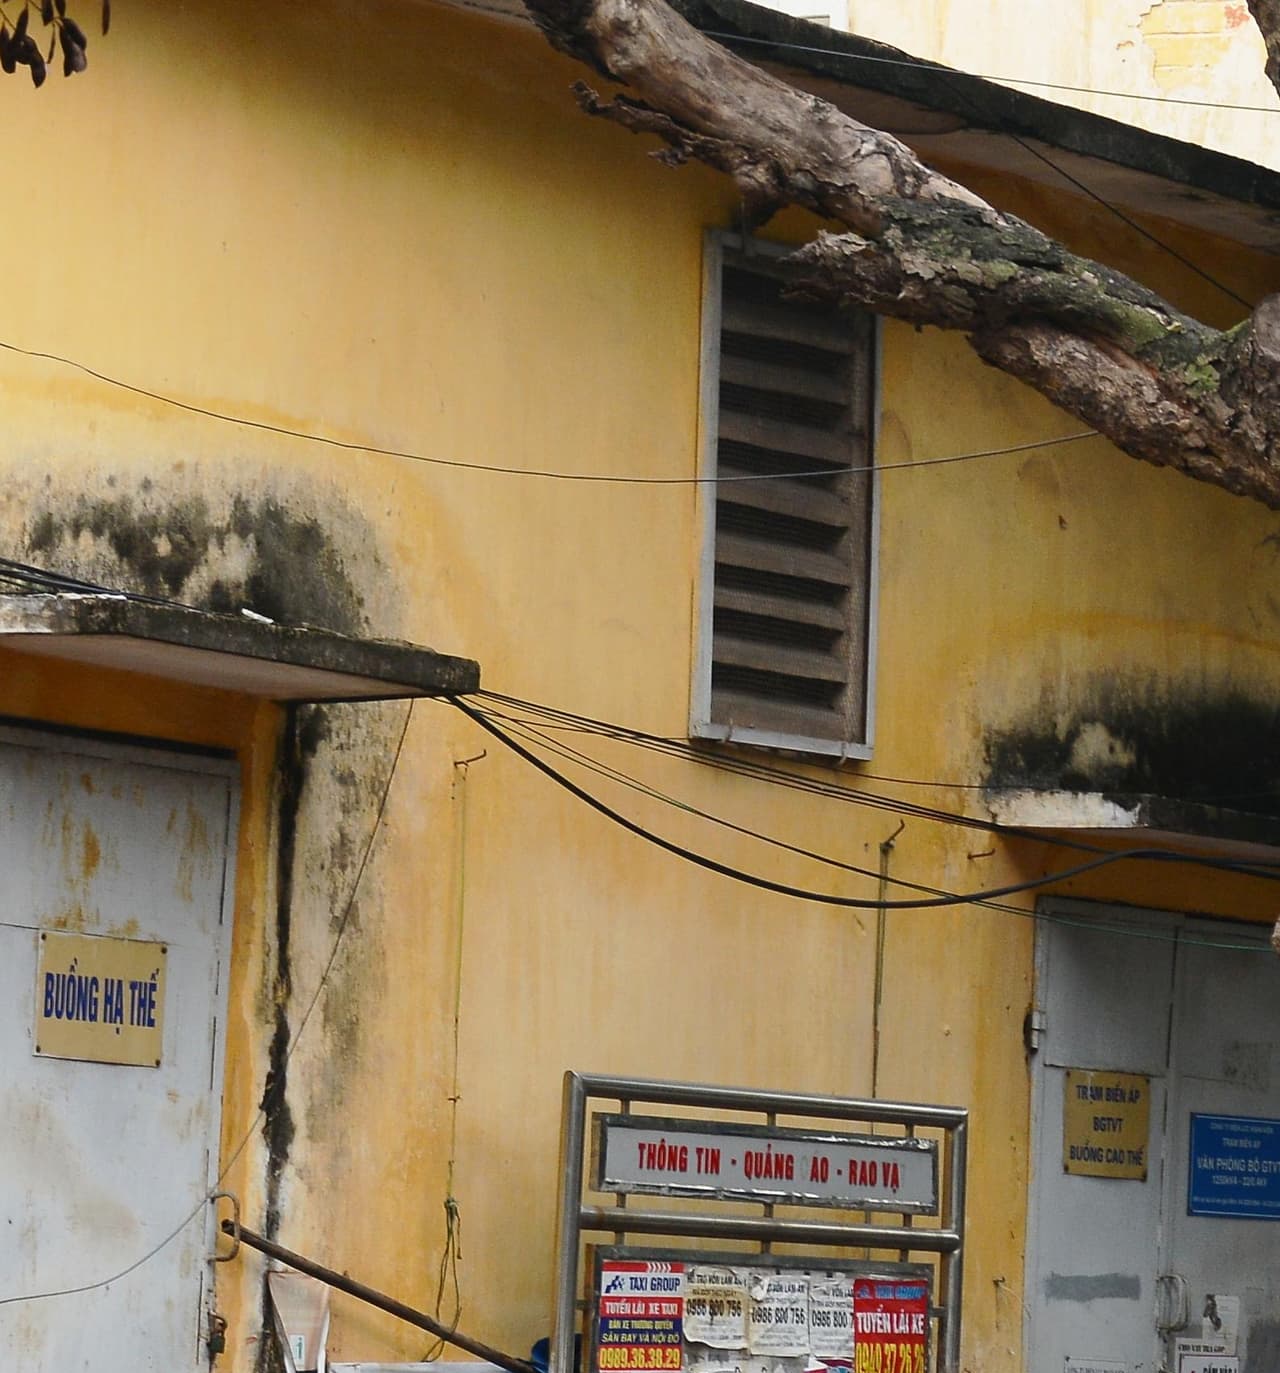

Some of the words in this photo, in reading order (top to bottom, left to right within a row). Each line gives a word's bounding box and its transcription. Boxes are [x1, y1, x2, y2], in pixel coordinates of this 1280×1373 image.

[44, 957, 100, 1024] BUỒNG
[102, 978, 125, 1036] HẠ
[129, 967, 160, 1029] THẾ
[1093, 1116, 1124, 1133] BGTVT
[638, 1138, 690, 1173] THÔNG
[696, 1147, 722, 1176] TIN
[849, 1160, 878, 1188] RAO
[1105, 1148, 1125, 1165] CAO
[629, 1276, 649, 1291] TAXI
[650, 1277, 682, 1292] GROUP
[911, 1312, 925, 1335] XE
